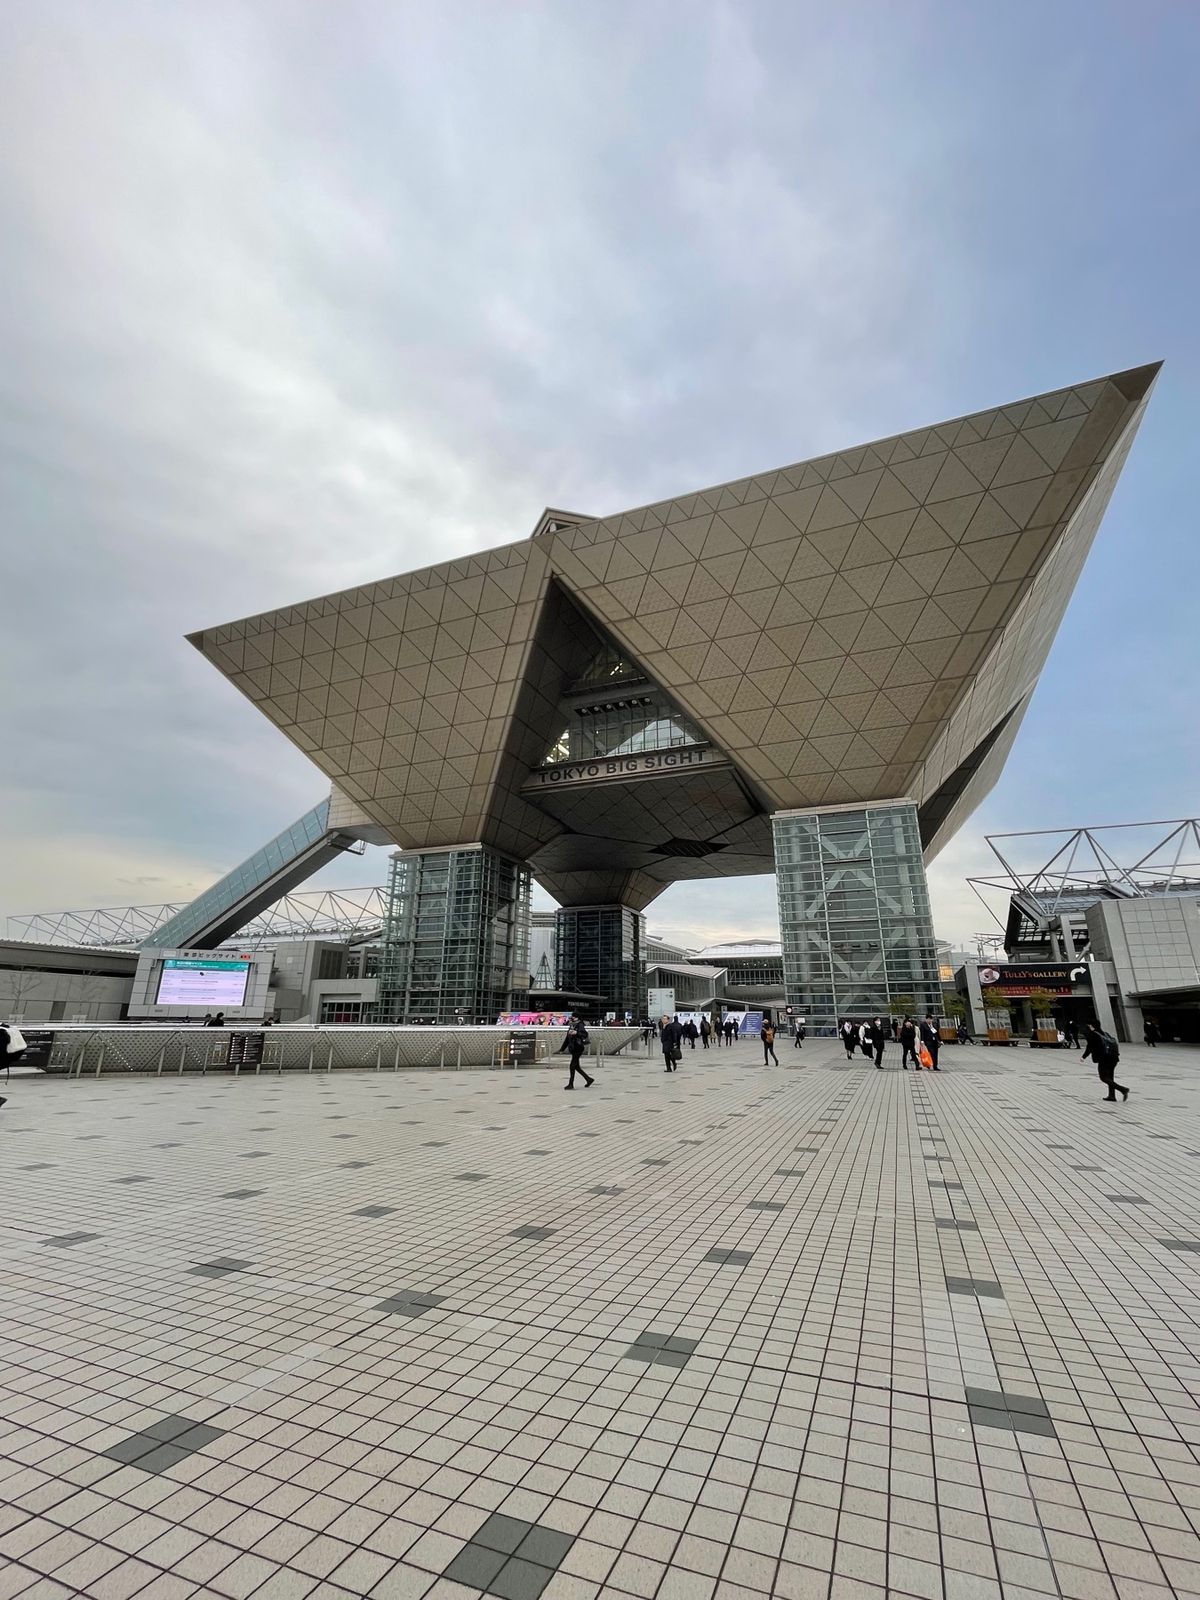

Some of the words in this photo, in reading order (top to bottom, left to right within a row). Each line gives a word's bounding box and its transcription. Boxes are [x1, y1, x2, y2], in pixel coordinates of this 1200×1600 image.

[538, 765, 599, 783] TOKYO
[606, 760, 638, 774] BIG
[644, 750, 707, 769] SIGHT
[1033, 970, 1067, 978] GALLERY
